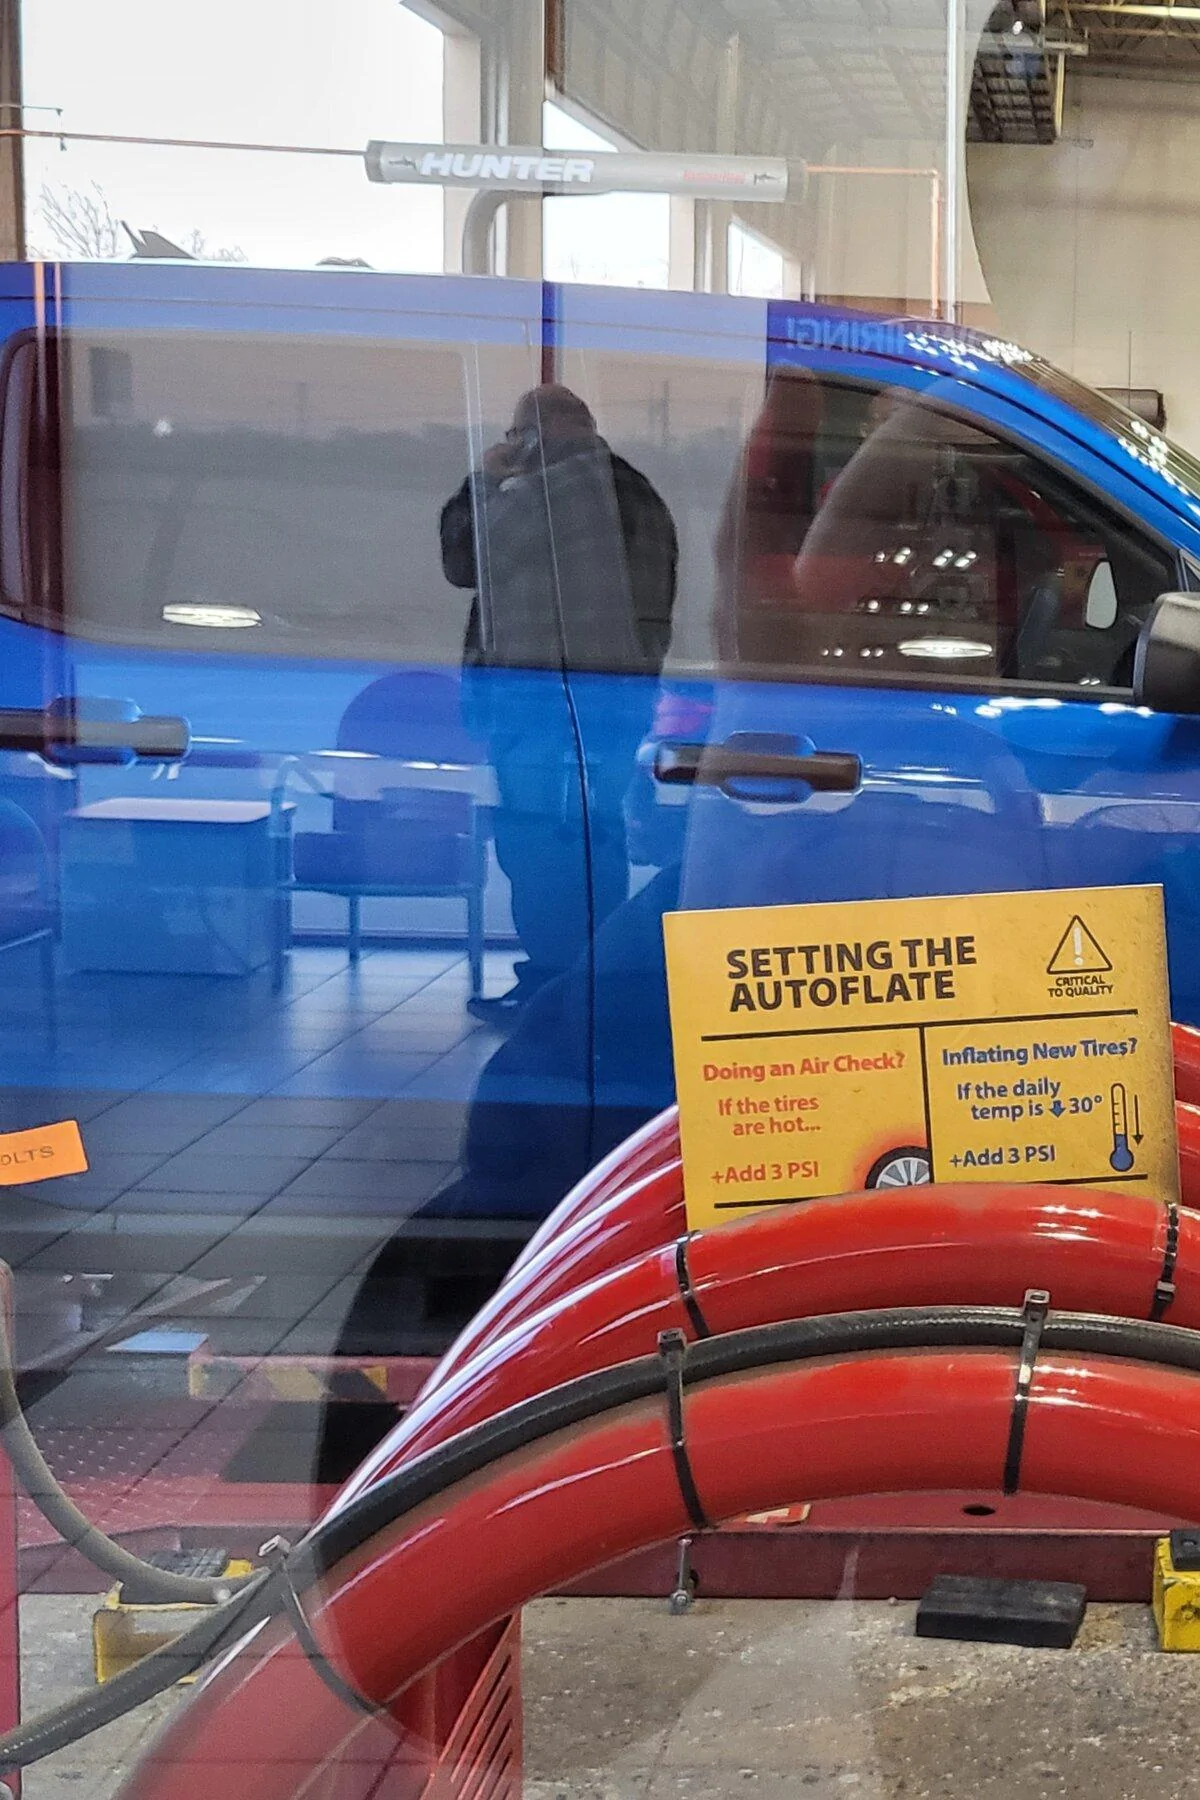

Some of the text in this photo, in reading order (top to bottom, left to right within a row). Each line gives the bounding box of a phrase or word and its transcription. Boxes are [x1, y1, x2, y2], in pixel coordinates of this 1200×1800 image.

[420, 152, 595, 183] HUNTER
[727, 936, 977, 980] SETTING THE
[730, 970, 955, 1012] AUTOFLATE
[1048, 985, 1113, 997] TO QUALITY
[1056, 975, 1106, 987] CRITICAL
[942, 1037, 1138, 1066] Inflating New Tires?
[703, 1051, 905, 1082] Doing an Air Check?
[957, 1077, 1061, 1100] If the daily
[718, 1094, 820, 1116] If the tires
[971, 1104, 1024, 1122] temp
[1028, 1100, 1044, 1117] is
[733, 1116, 821, 1136] are hot...
[949, 1144, 1055, 1168] +Add 3 PSI
[711, 1160, 819, 1184] +Add 3 PSI
